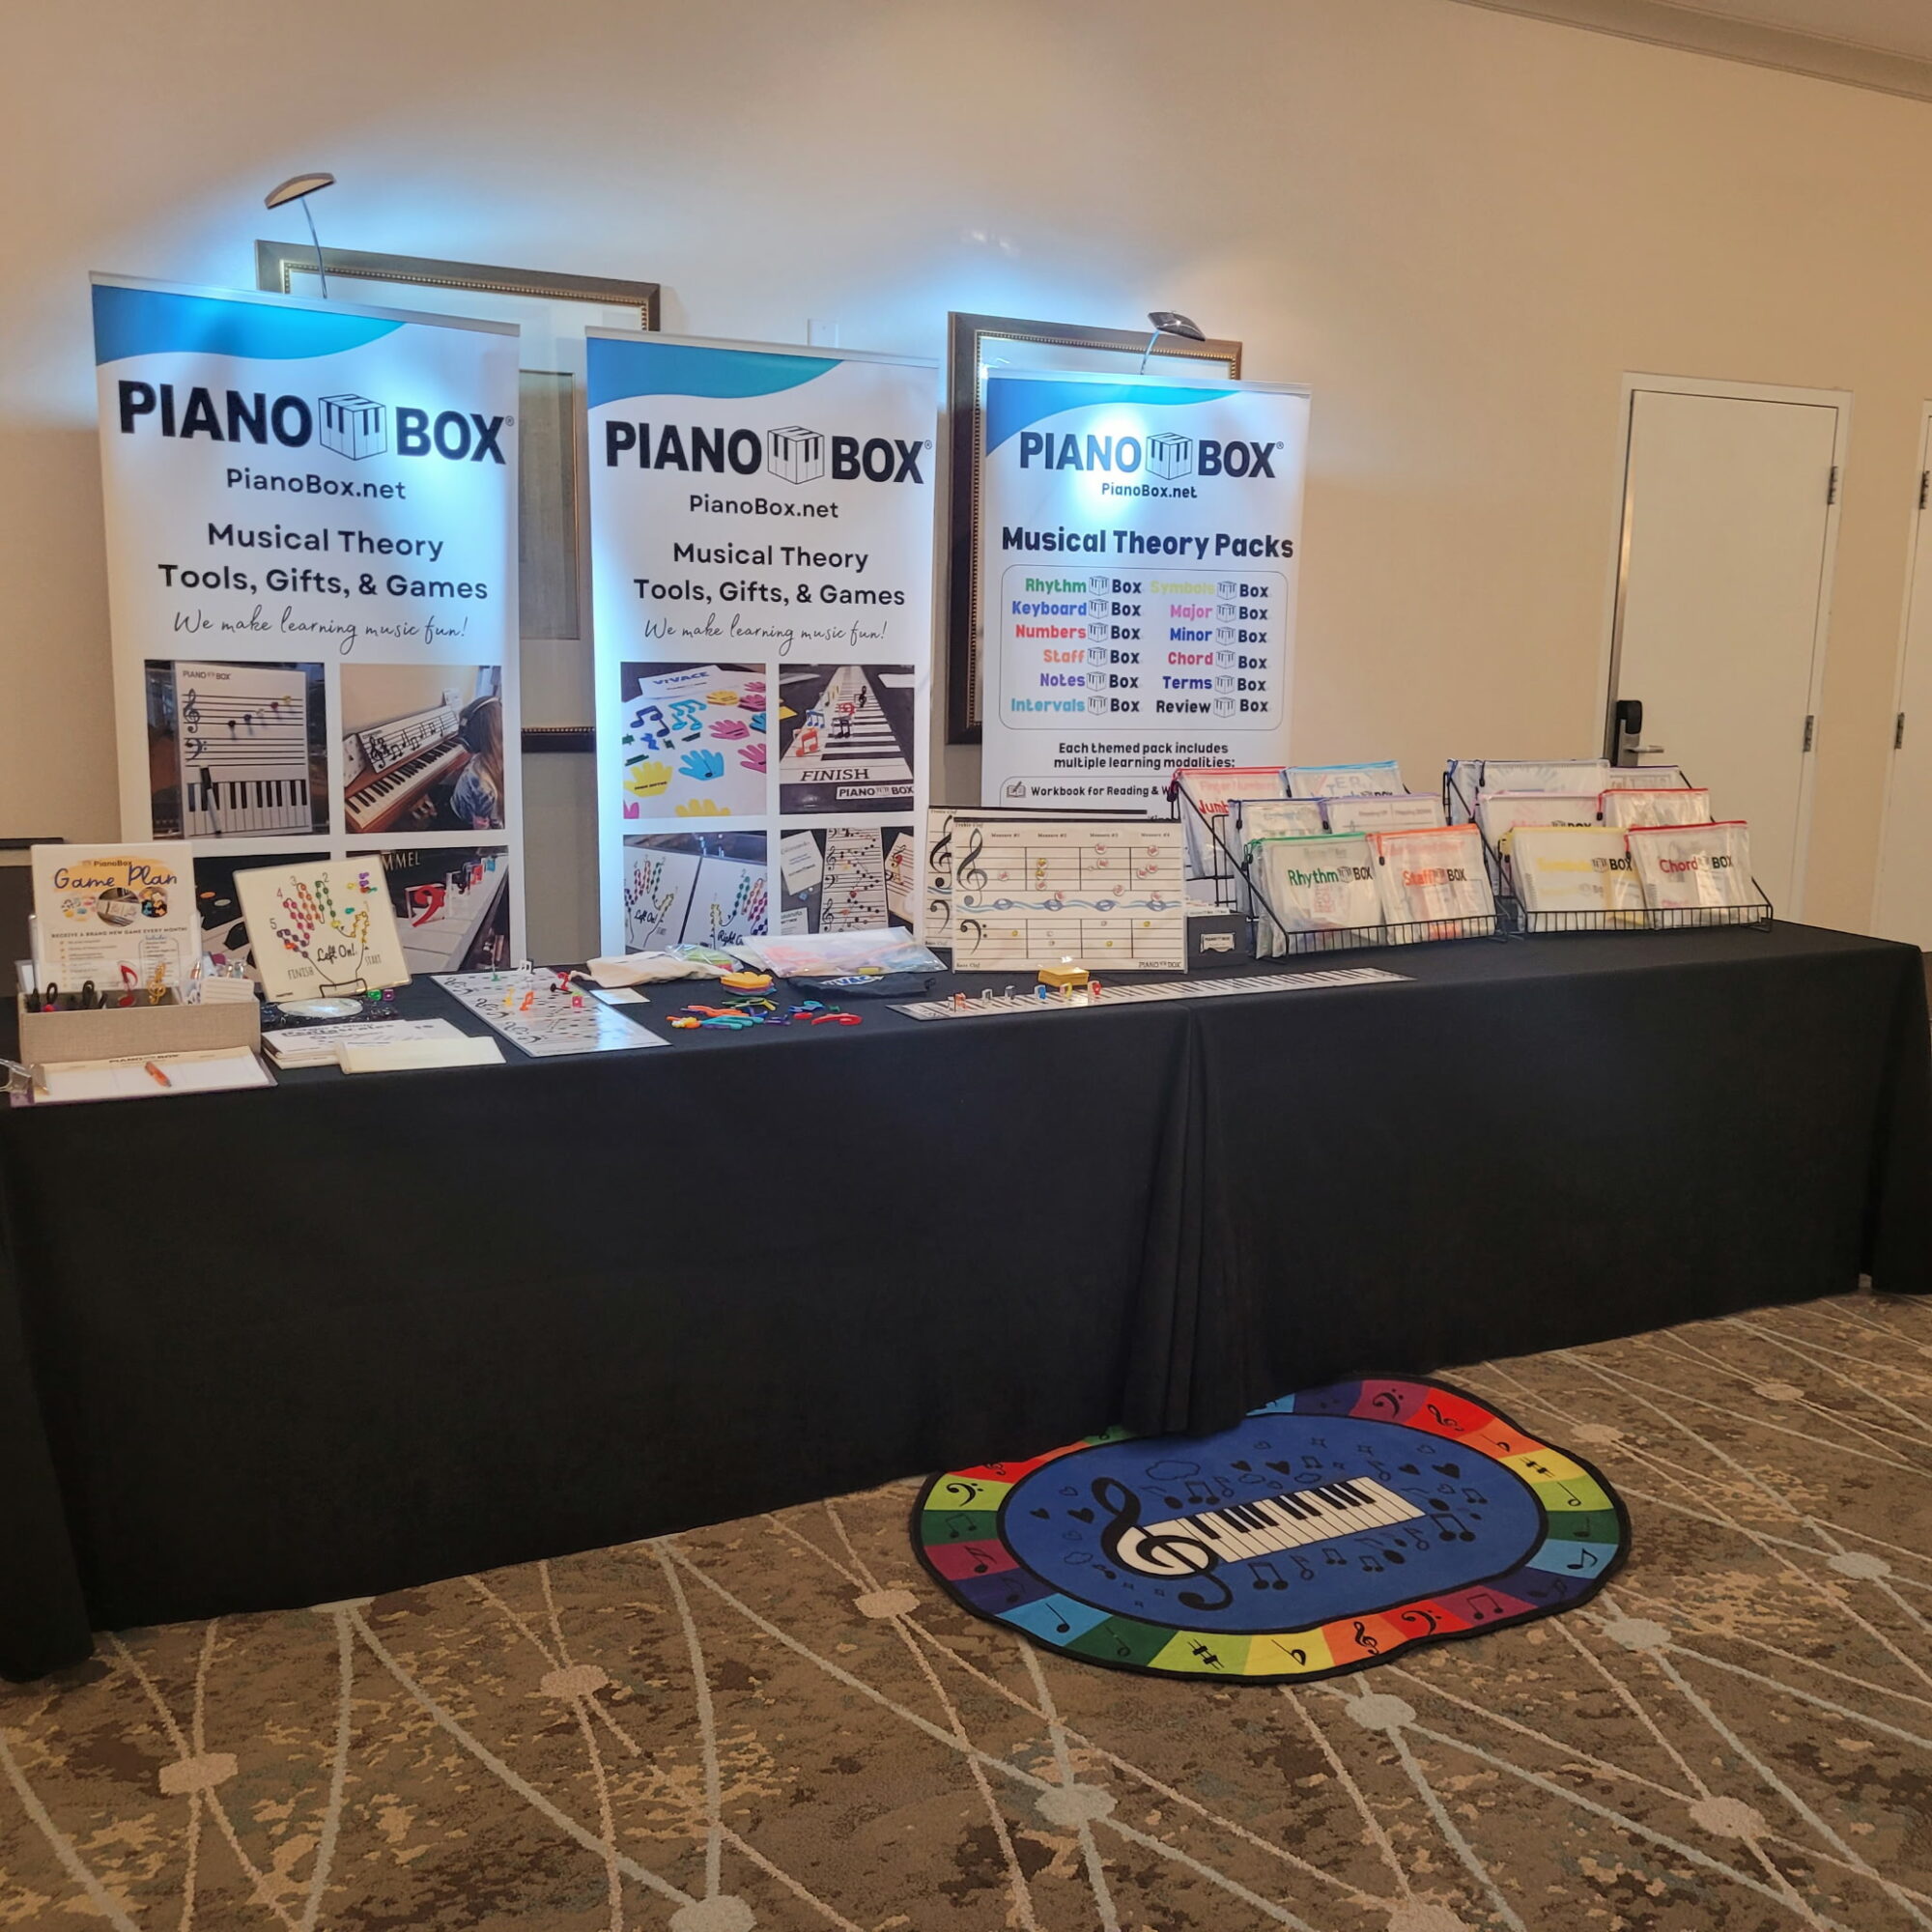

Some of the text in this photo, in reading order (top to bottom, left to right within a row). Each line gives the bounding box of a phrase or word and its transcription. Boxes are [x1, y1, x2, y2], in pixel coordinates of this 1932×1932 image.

[118, 380, 313, 447] PIANO
[606, 420, 762, 475] PIANO
[1019, 431, 1143, 473] PIANO
[226, 468, 407, 499] PianoBox.net
[1101, 482, 1198, 498] PianoBox.net
[690, 493, 839, 518] PianoBox.net
[207, 522, 444, 562] Musical Theory
[1002, 526, 1293, 560] Musical Theory Packs
[673, 542, 869, 574] Musical Theory
[157, 563, 489, 600] Tools, Gifts, & Games
[1025, 578, 1143, 597] Rhythm Box
[633, 579, 906, 608] Tools, Gifts, & Games
[1239, 583, 1269, 599] Box
[1011, 600, 1142, 619] Keyboard Box
[1170, 604, 1268, 622] Major Box
[174, 605, 469, 655] We make learning music fun!
[644, 612, 888, 657] We make learning music fun!
[1015, 624, 1141, 640] Numbers Box
[1170, 627, 1267, 644] Minor Box
[1043, 649, 1140, 665] Staff Box
[1167, 651, 1267, 669] Chord Box
[653, 671, 710, 685] VIVACE
[1039, 672, 1139, 690] Notes Box
[1162, 675, 1266, 692] Terms Box
[1011, 697, 1140, 713] Intervals Box
[1156, 698, 1268, 714] Review Box
[1059, 742, 1229, 756] Each themed pack includes
[1054, 756, 1236, 771] multiple learning modalities:
[800, 768, 871, 782] FINISH
[838, 785, 914, 798] PIANO BOX
[1031, 785, 1085, 797] Workbook
[1088, 785, 1104, 796] for
[1107, 785, 1150, 798] Reading
[1151, 786, 1160, 796] &
[93, 859, 133, 867] PianoBox
[381, 851, 422, 871] MMEL
[1608, 857, 1633, 871] BOX
[1659, 856, 1733, 873] Chord BOX
[54, 865, 178, 890] Game Plan
[322, 871, 330, 883] 2
[1288, 867, 1374, 889] Rhythm BOX
[1447, 868, 1467, 882] BOX
[276, 888, 284, 898] 4
[270, 918, 277, 929] 5
[317, 946, 338, 964] Left
[287, 967, 315, 980] FINISH
